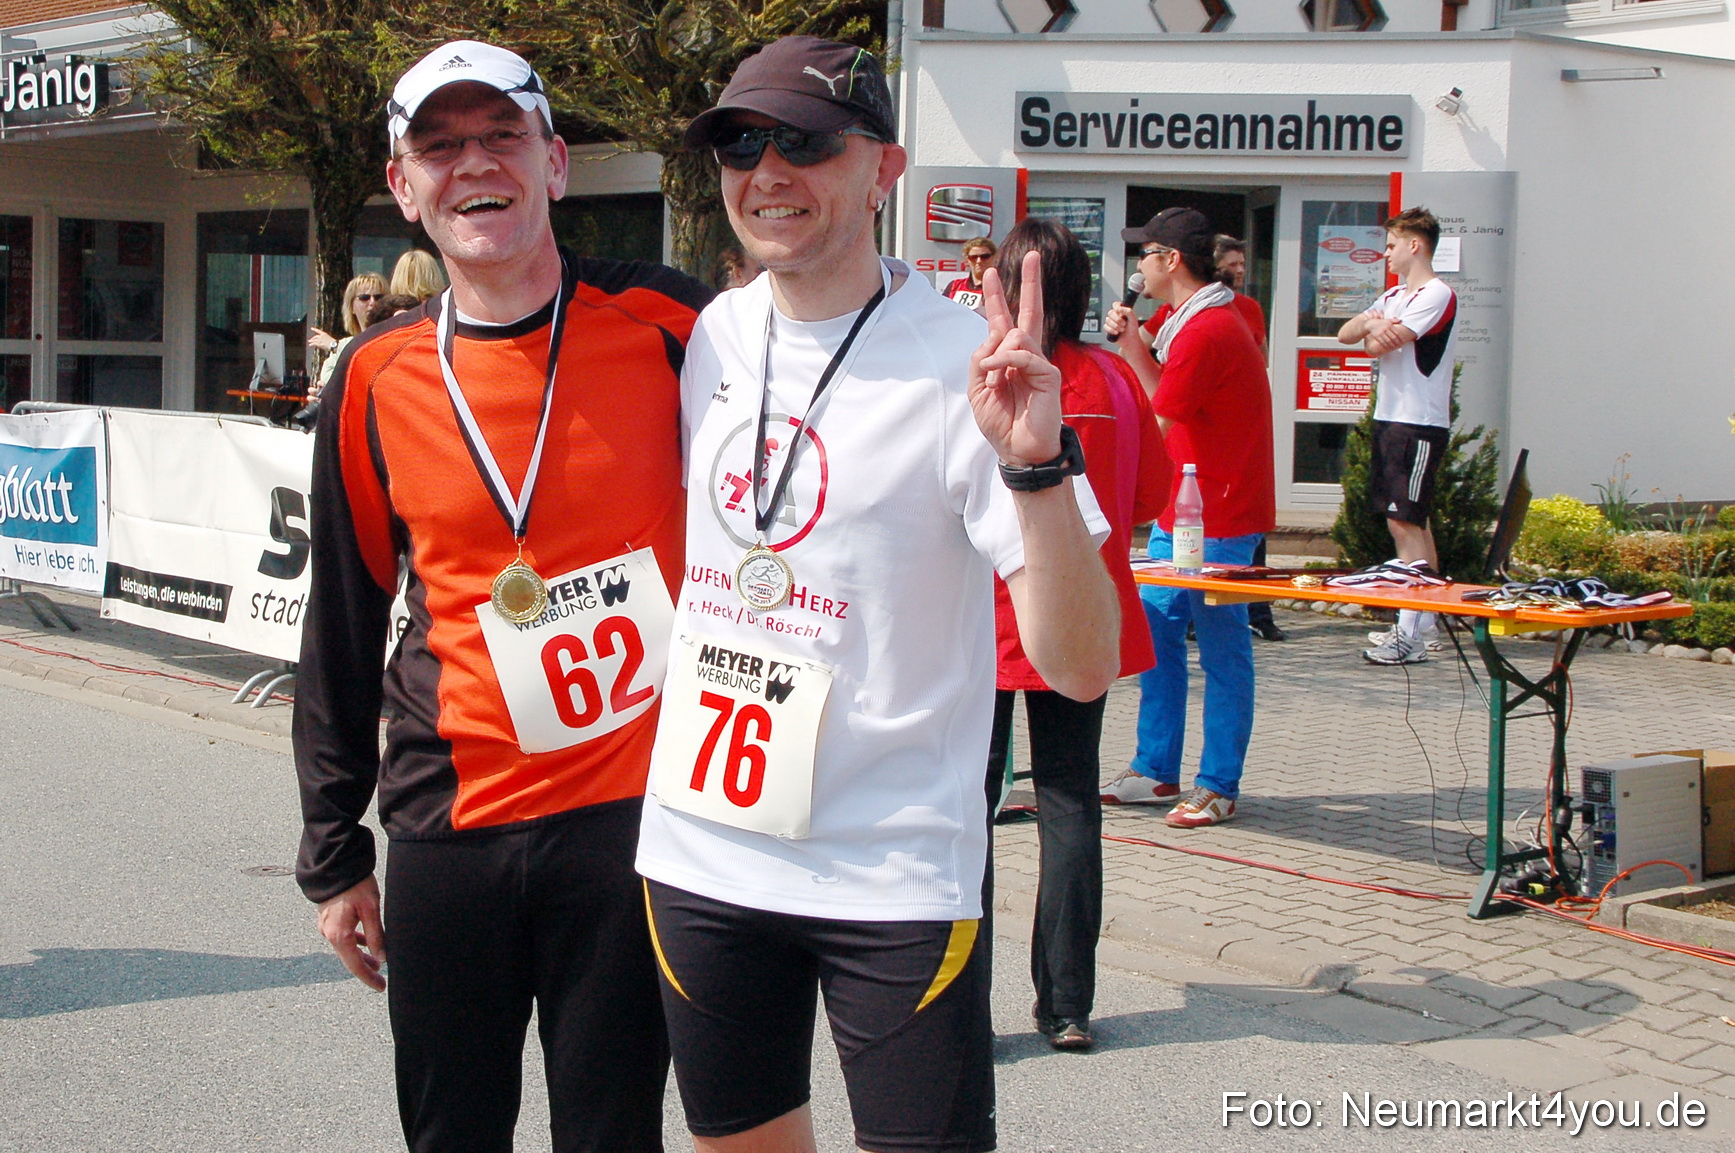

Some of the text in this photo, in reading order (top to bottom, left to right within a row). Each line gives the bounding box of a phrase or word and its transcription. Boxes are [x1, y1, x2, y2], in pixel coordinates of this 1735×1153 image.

[438, 62, 472, 72] adidas
[4, 54, 96, 116] Jänig
[1020, 96, 1403, 151] Serviceannahme
[1459, 226, 1468, 234] &
[958, 292, 978, 307] 83
[1468, 285, 1502, 293] Leasing
[14, 543, 99, 574] Hier lebe ich.
[119, 576, 223, 612] Leistungen, die verbinden
[685, 564, 731, 591] UFEN
[250, 588, 308, 627] stad
[513, 595, 598, 633] WERBUNG
[701, 600, 733, 620] Heck
[736, 607, 744, 625] /
[747, 611, 763, 629] Dr.
[765, 616, 822, 638] Röschl
[540, 615, 655, 729] 62
[698, 643, 764, 678] MEYER
[696, 664, 761, 694] WERBUNG
[689, 690, 772, 808] 76
